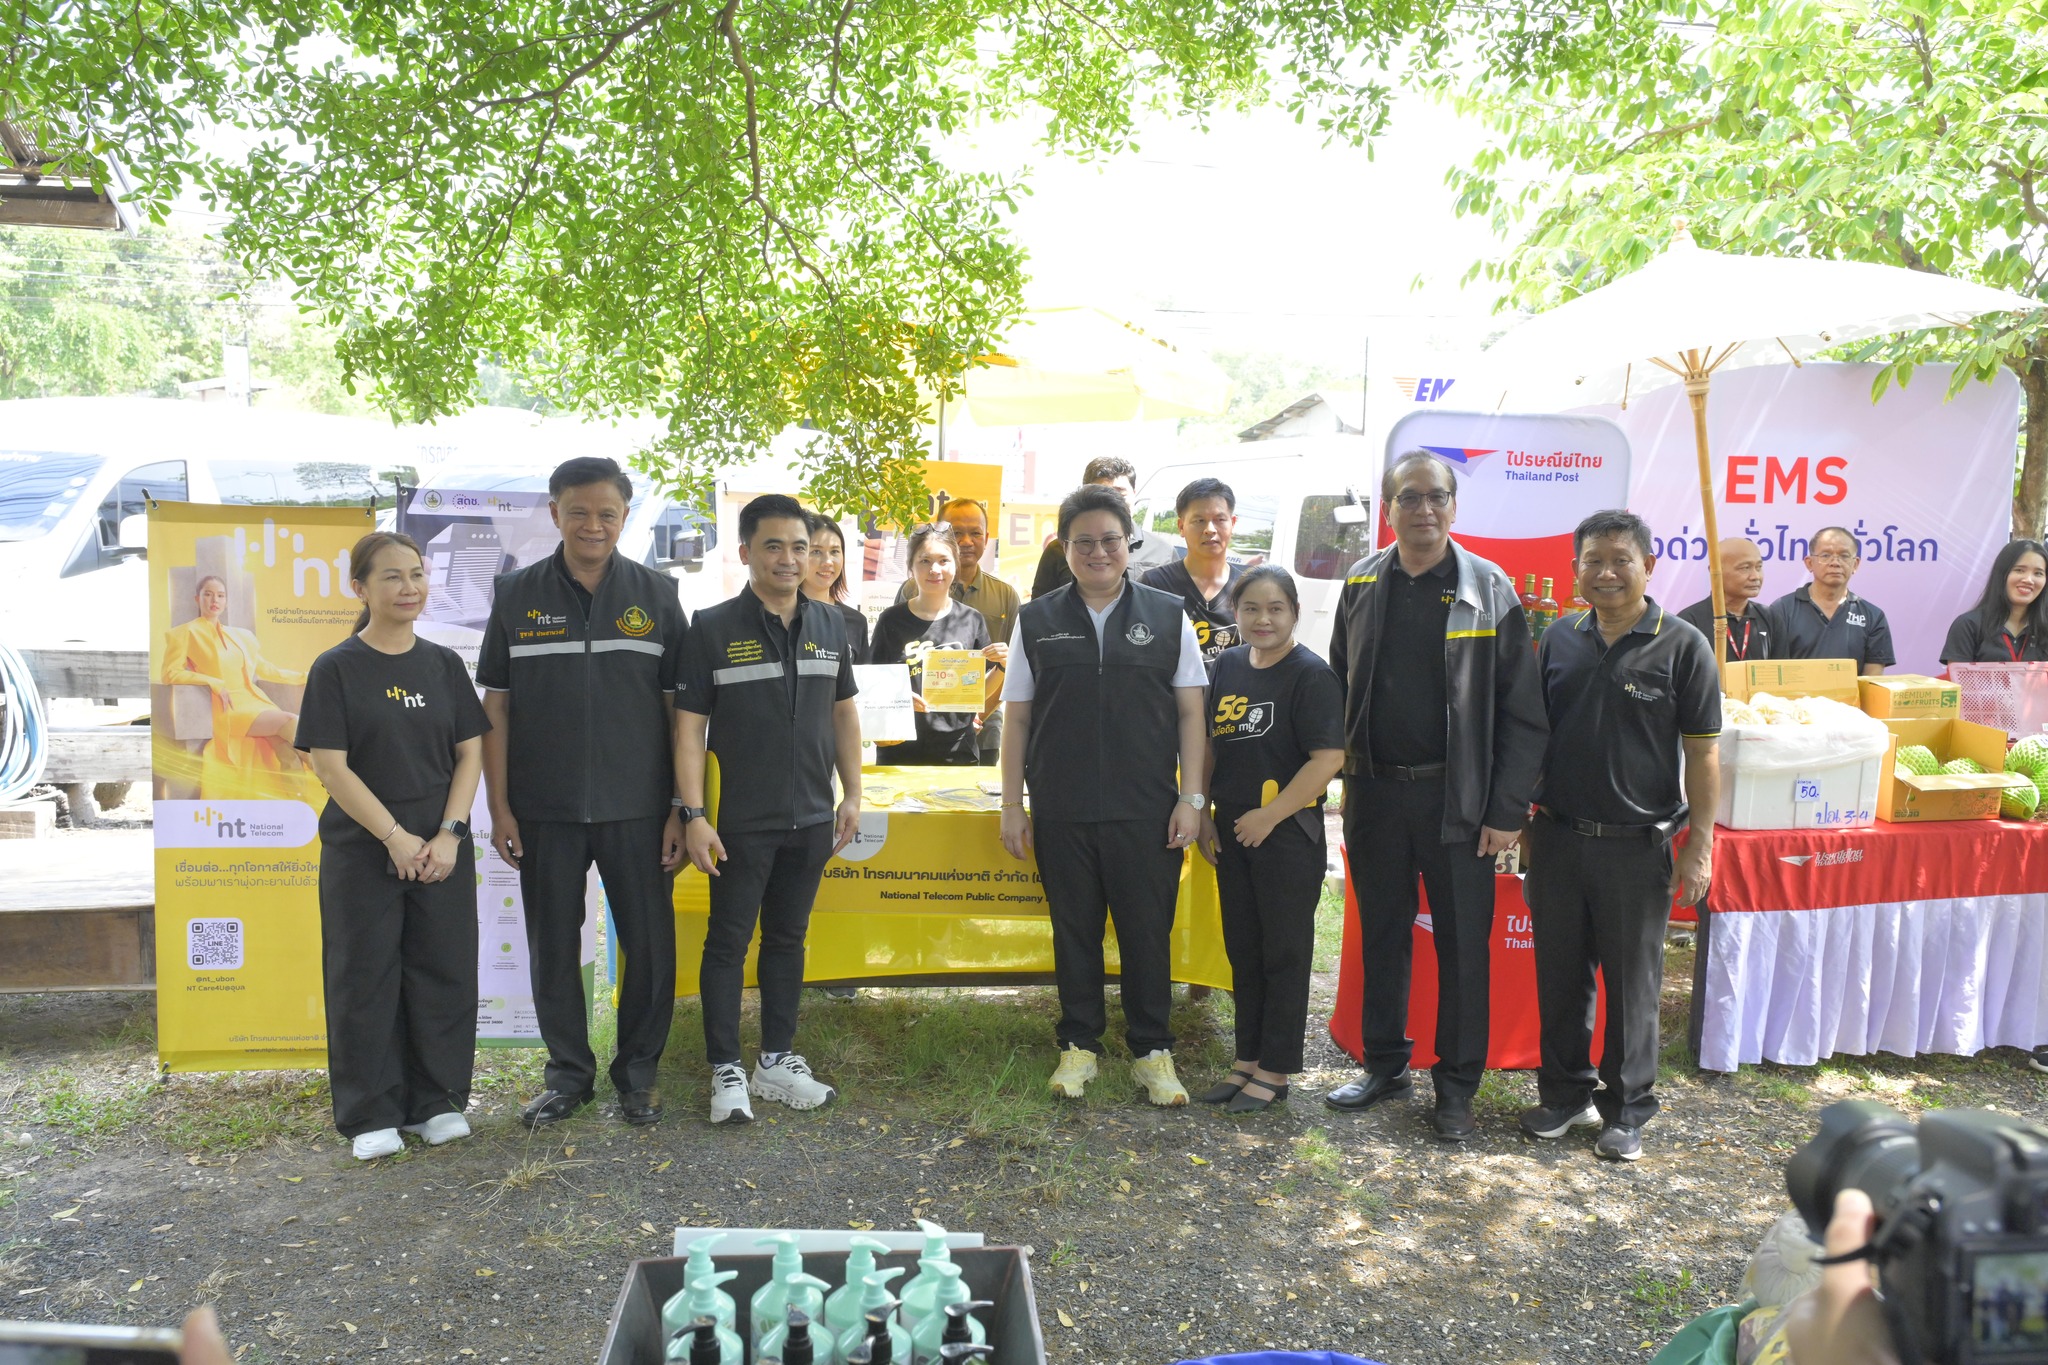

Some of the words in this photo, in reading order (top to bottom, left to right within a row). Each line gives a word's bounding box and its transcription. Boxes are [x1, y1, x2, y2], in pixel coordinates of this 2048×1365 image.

[1414, 377, 1456, 402] EM
[1506, 450, 1603, 469] ไปรษณีย์ไทย
[1505, 470, 1552, 482] Thailand
[1555, 472, 1579, 482] Post
[1725, 456, 1848, 505] EMS
[498, 502, 512, 512] nt
[537, 613, 552, 625] nt
[1847, 611, 1866, 623] THP
[815, 647, 827, 659] nt
[404, 692, 426, 708] nt
[1894, 691, 1932, 699] PREMIUM
[1915, 698, 1940, 706] FRUITS
[1215, 695, 1249, 723] 5G
[1239, 722, 1255, 733] my
[217, 818, 247, 838] nt
[249, 823, 284, 831] National
[175, 859, 319, 875] เชื่อมต่อ...ทุกโอกาสให้ยิ่งให
[823, 867, 860, 879] บริษัท
[863, 867, 990, 882] โทรคมนาคมแห่งชาติ
[994, 870, 1029, 883] จำกัด
[175, 876, 319, 889] พร้อมพาเราพุ่งทะยานไปด้ว
[880, 891, 920, 900] National
[923, 892, 963, 901] Telecom
[966, 893, 995, 901] Public
[998, 894, 1043, 903] Company
